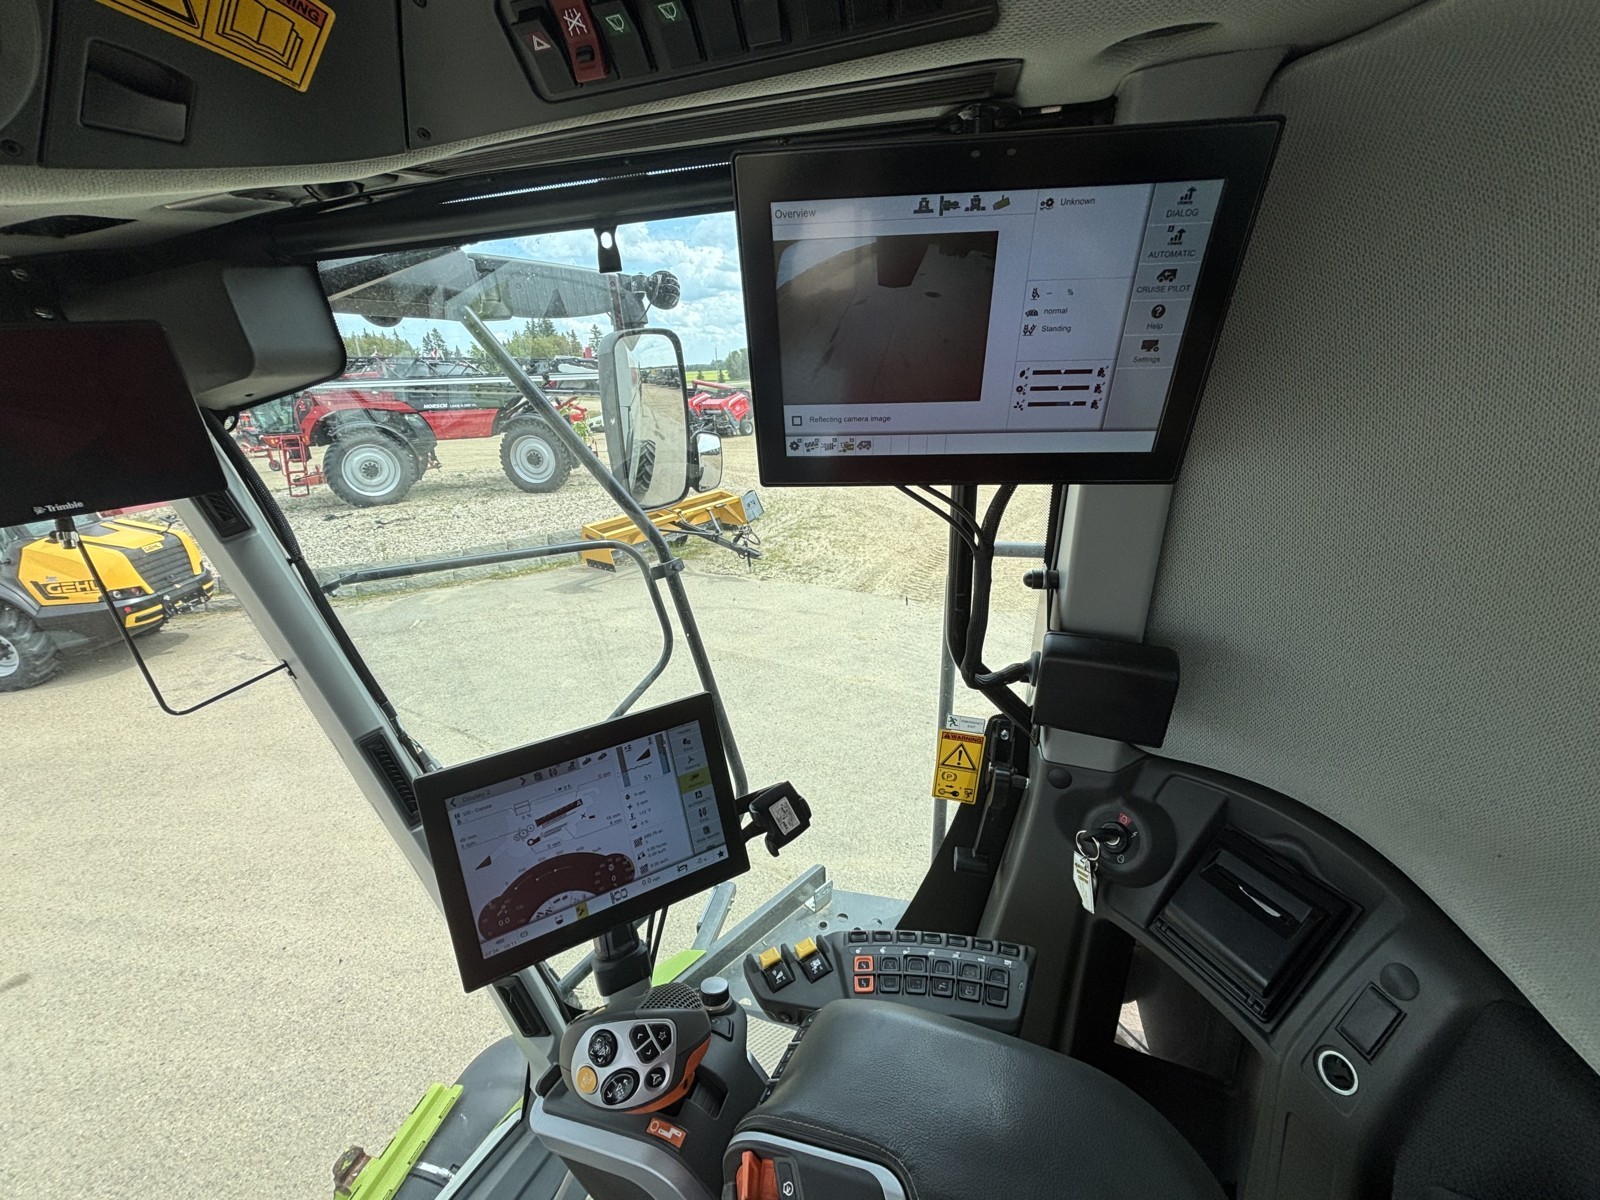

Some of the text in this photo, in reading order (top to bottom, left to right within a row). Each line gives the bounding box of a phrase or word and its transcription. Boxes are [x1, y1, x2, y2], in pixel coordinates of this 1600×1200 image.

[1060, 197, 1096, 206] Unknown
[774, 208, 816, 219] Overview
[1166, 208, 1199, 218] DIALOG
[1148, 250, 1196, 259] AUTOMATIC
[1136, 284, 1191, 294] CRUISE PILOT
[1041, 324, 1072, 333] Standing
[1146, 322, 1163, 330] Help
[1132, 356, 1160, 364] Settings
[809, 416, 842, 424] Reflecting
[45, 500, 84, 512] Trimble
[46, 580, 100, 594] GEHL
[952, 734, 982, 743] WARNING
